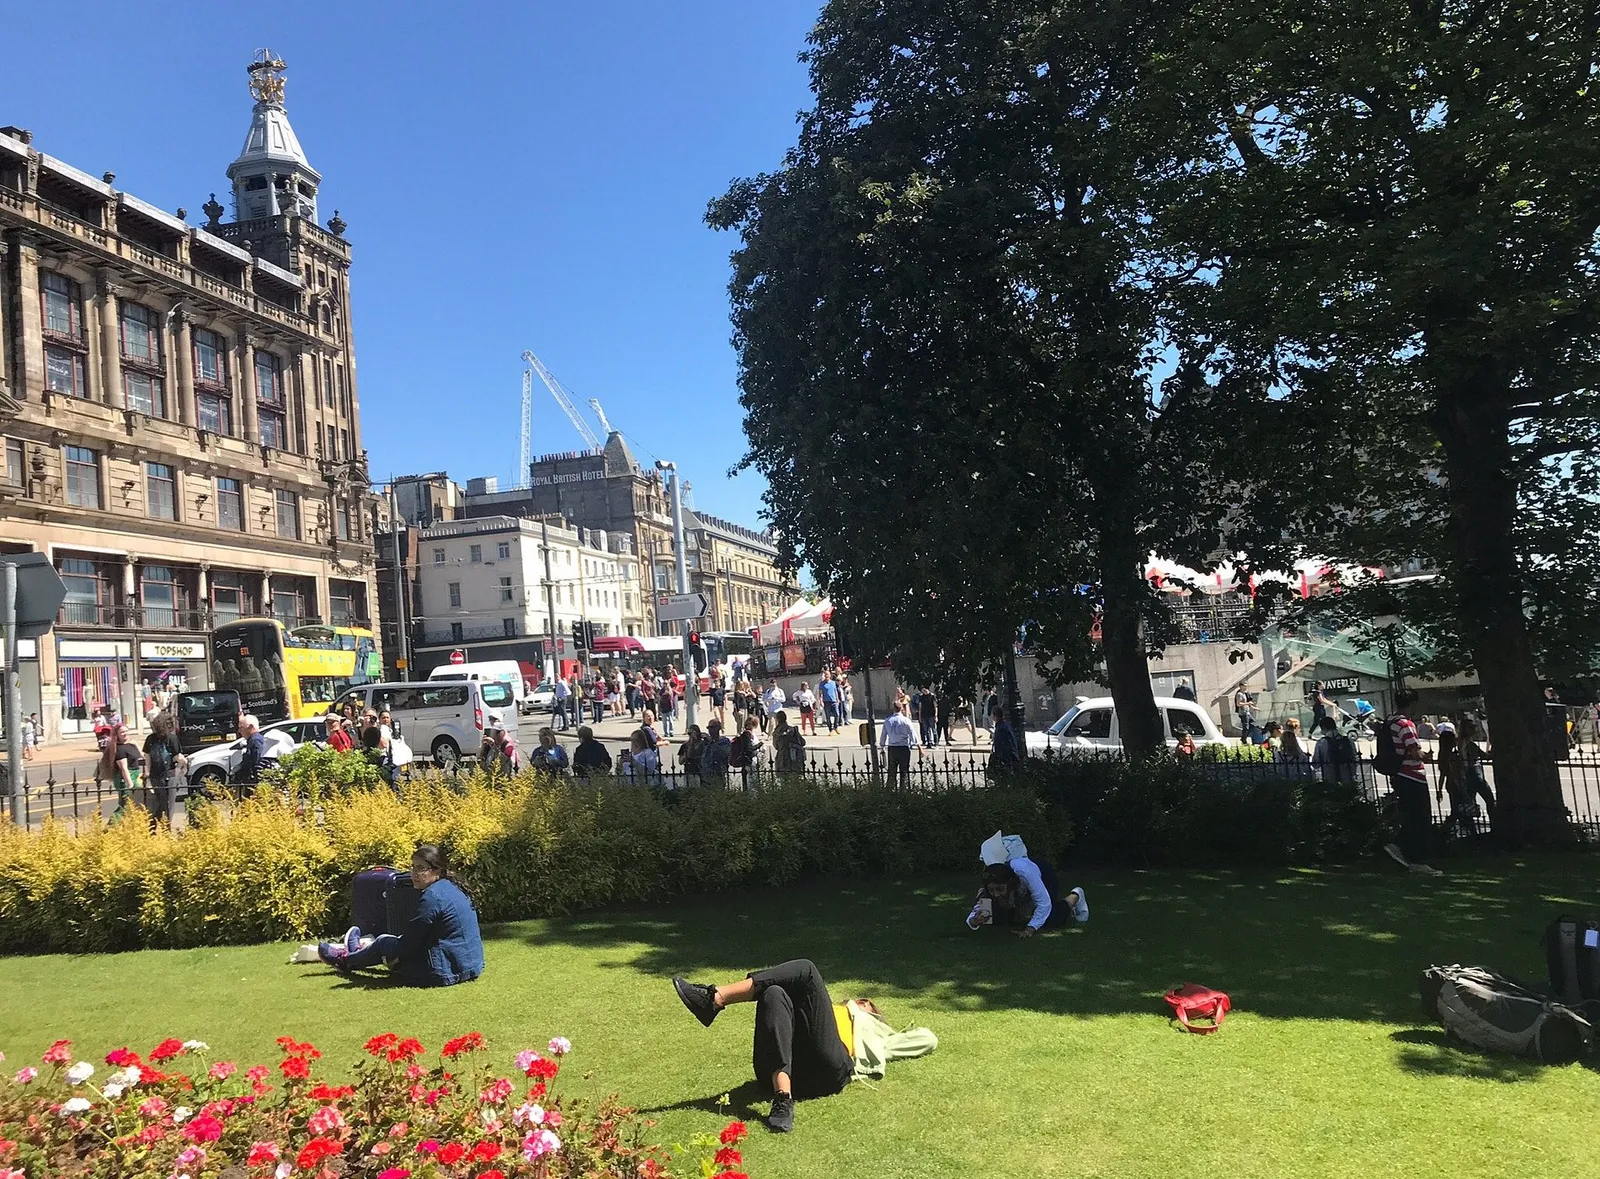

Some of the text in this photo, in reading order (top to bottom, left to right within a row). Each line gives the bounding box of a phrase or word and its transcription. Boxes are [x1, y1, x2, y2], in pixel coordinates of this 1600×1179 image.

[530, 470, 605, 486] ROYAL BRITISH HOTEL
[155, 645, 193, 656] TOPSHOP
[168, 675, 186, 686] SALE
[247, 699, 278, 708] Scotland's
